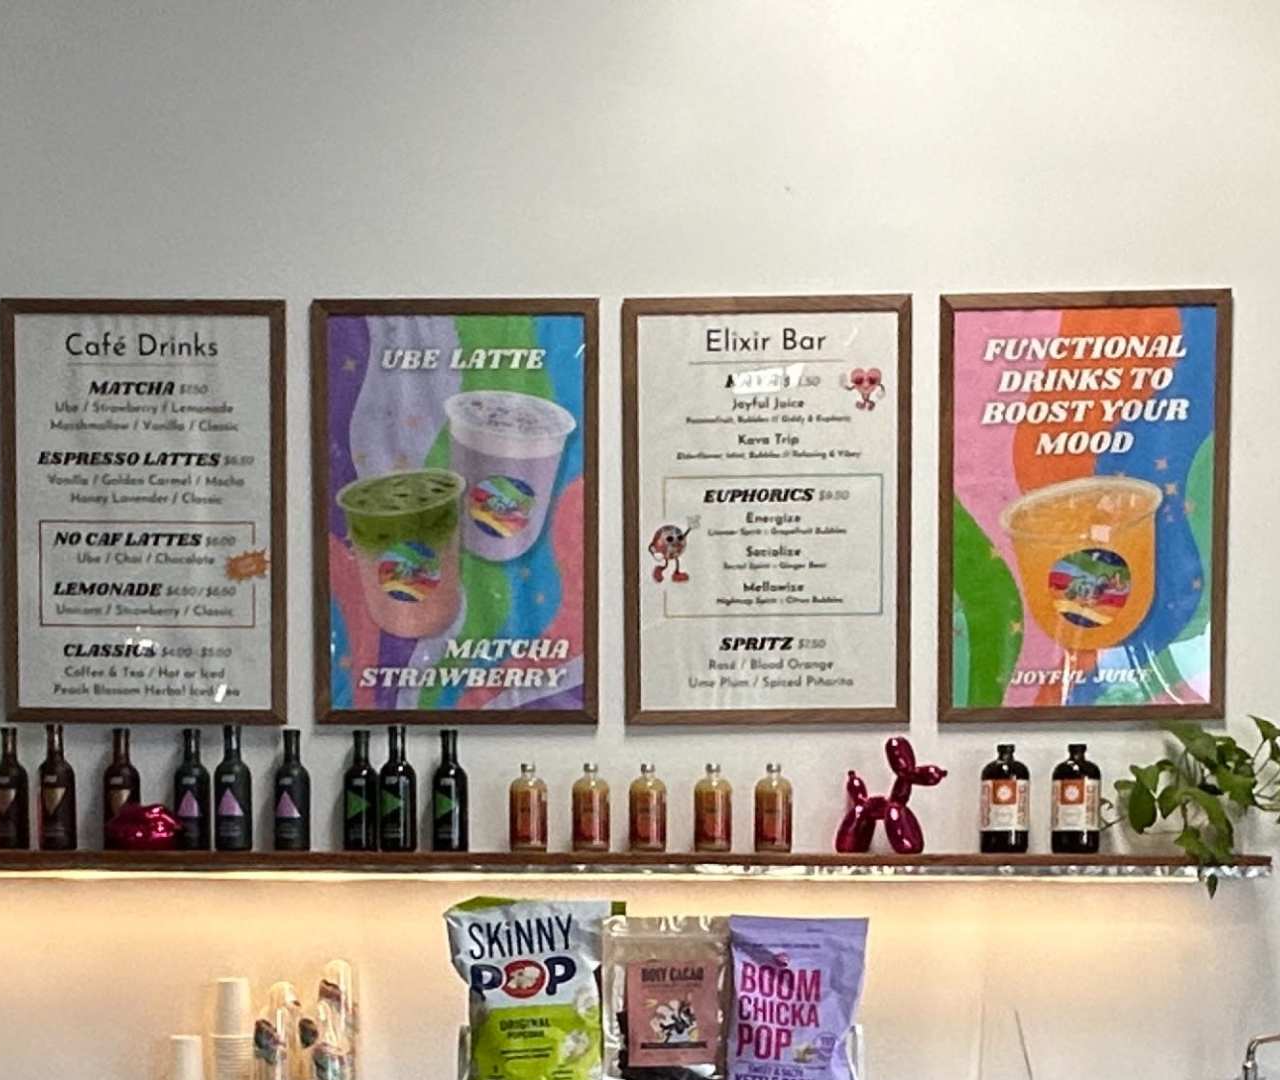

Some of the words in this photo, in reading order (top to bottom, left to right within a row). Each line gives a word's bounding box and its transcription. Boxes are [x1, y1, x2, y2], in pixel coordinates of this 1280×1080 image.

[66, 333, 126, 356] Café
[139, 332, 218, 357] Drinks
[706, 327, 770, 352] Elixir
[783, 327, 826, 351] Bar
[984, 335, 1187, 362] FUNCTIONAL
[381, 349, 440, 369] UBE
[450, 349, 546, 369] LATTE
[999, 367, 1121, 393] DRINKS
[1130, 366, 1173, 391] TO
[89, 381, 175, 395] MATCHA
[55, 401, 78, 412] Ube
[93, 402, 157, 415] Strawberry
[172, 402, 233, 413] Lemonade
[732, 396, 770, 411] Joyful
[774, 396, 805, 410] Juice
[981, 401, 1094, 425] BOOST
[1102, 399, 1188, 422] YOUR
[50, 420, 128, 431] Marshmallow
[142, 420, 184, 431] Vanilla
[199, 420, 239, 432] Classic
[738, 434, 770, 446] Kava
[775, 433, 800, 447] Trip
[1036, 431, 1135, 455] MOOD
[37, 451, 140, 466] ESPRESSO
[143, 452, 221, 466] LATTES
[47, 474, 88, 485] Vanilla
[102, 474, 144, 485] Golden
[205, 475, 244, 487] Mocha
[70, 492, 108, 505] Honey
[182, 492, 223, 504] Classic
[703, 488, 815, 503] EUPHORICS
[746, 511, 801, 526] Energize
[53, 532, 81, 546] NO
[85, 532, 122, 546] CAF
[124, 533, 202, 547] LATTES
[746, 545, 801, 557] Socialize
[77, 553, 100, 564] Ube
[114, 553, 142, 565] Chai
[155, 553, 215, 565] Chocolate
[53, 582, 162, 596] LEMONADE
[743, 581, 804, 592] Mellowize
[115, 605, 180, 618] Strawberry
[193, 605, 234, 617] Classic
[63, 643, 156, 657] CLASSICS
[445, 639, 569, 660] MATCHA
[719, 636, 794, 651] SPRITZ
[63, 666, 104, 678] Coffee
[123, 667, 145, 678] Tea
[158, 667, 180, 678] Hot
[183, 669, 196, 678] or
[201, 666, 225, 678] Iced
[750, 658, 784, 670] Blood
[787, 657, 834, 672] Orange
[360, 667, 567, 689] STRAWBERRY
[688, 677, 716, 688] Ume
[720, 676, 749, 688] Plum
[762, 675, 801, 689] Spiced
[1010, 668, 1087, 685] JOYFUL
[1093, 667, 1154, 685] JUICE
[53, 684, 89, 695] Peach
[93, 684, 140, 695] Blossom
[216, 685, 240, 697] ea
[470, 956, 577, 998] POP
[741, 960, 821, 1001] BOOM
[738, 995, 819, 1028] CHICKA
[736, 1023, 792, 1061] POP
